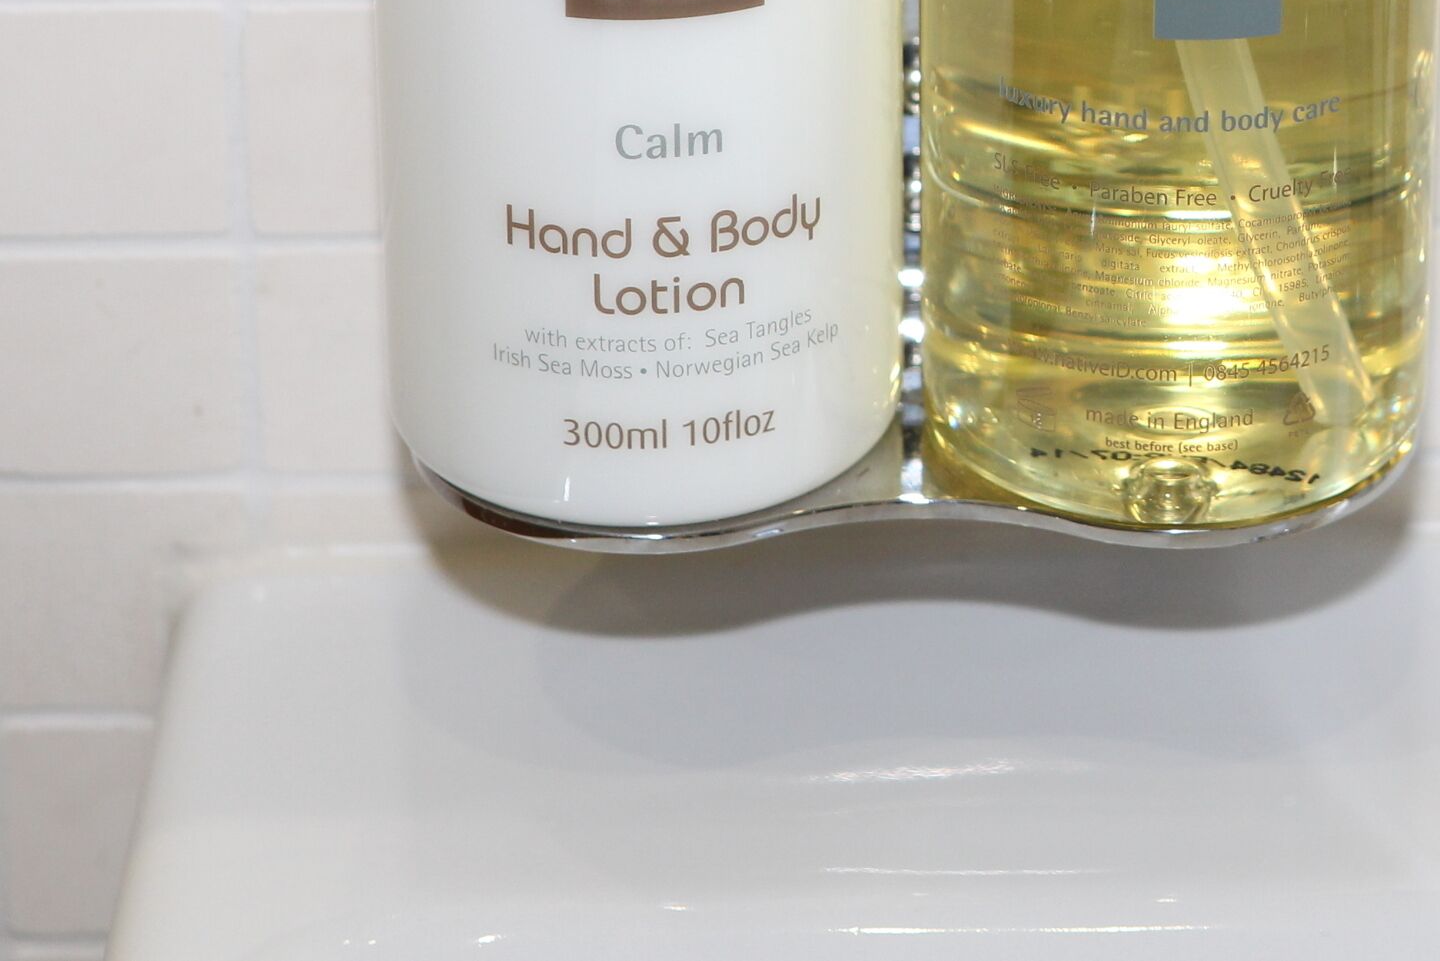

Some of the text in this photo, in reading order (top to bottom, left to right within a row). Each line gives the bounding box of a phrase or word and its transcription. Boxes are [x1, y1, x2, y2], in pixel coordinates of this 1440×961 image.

[1000, 76, 1341, 134] luxury hand and body care
[614, 122, 723, 160] Calm
[1090, 181, 1168, 205] Paraben
[1175, 189, 1217, 206] Free
[1248, 177, 1313, 203] Cruelty
[506, 193, 821, 259] Hand & Body
[1148, 233, 1191, 247] Glyceryl
[593, 273, 745, 316] Lotion
[493, 322, 839, 379] Irish Sea Moss Norwegian Sea Kelp
[525, 309, 812, 353] with extracts of: Sea Tangles
[1204, 362, 1250, 381] 0845
[1256, 344, 1330, 376] 4564215
[563, 409, 775, 450] 300ml 10floz
[1086, 407, 1254, 434] made in England
[1105, 436, 1239, 454] best before (see base)
